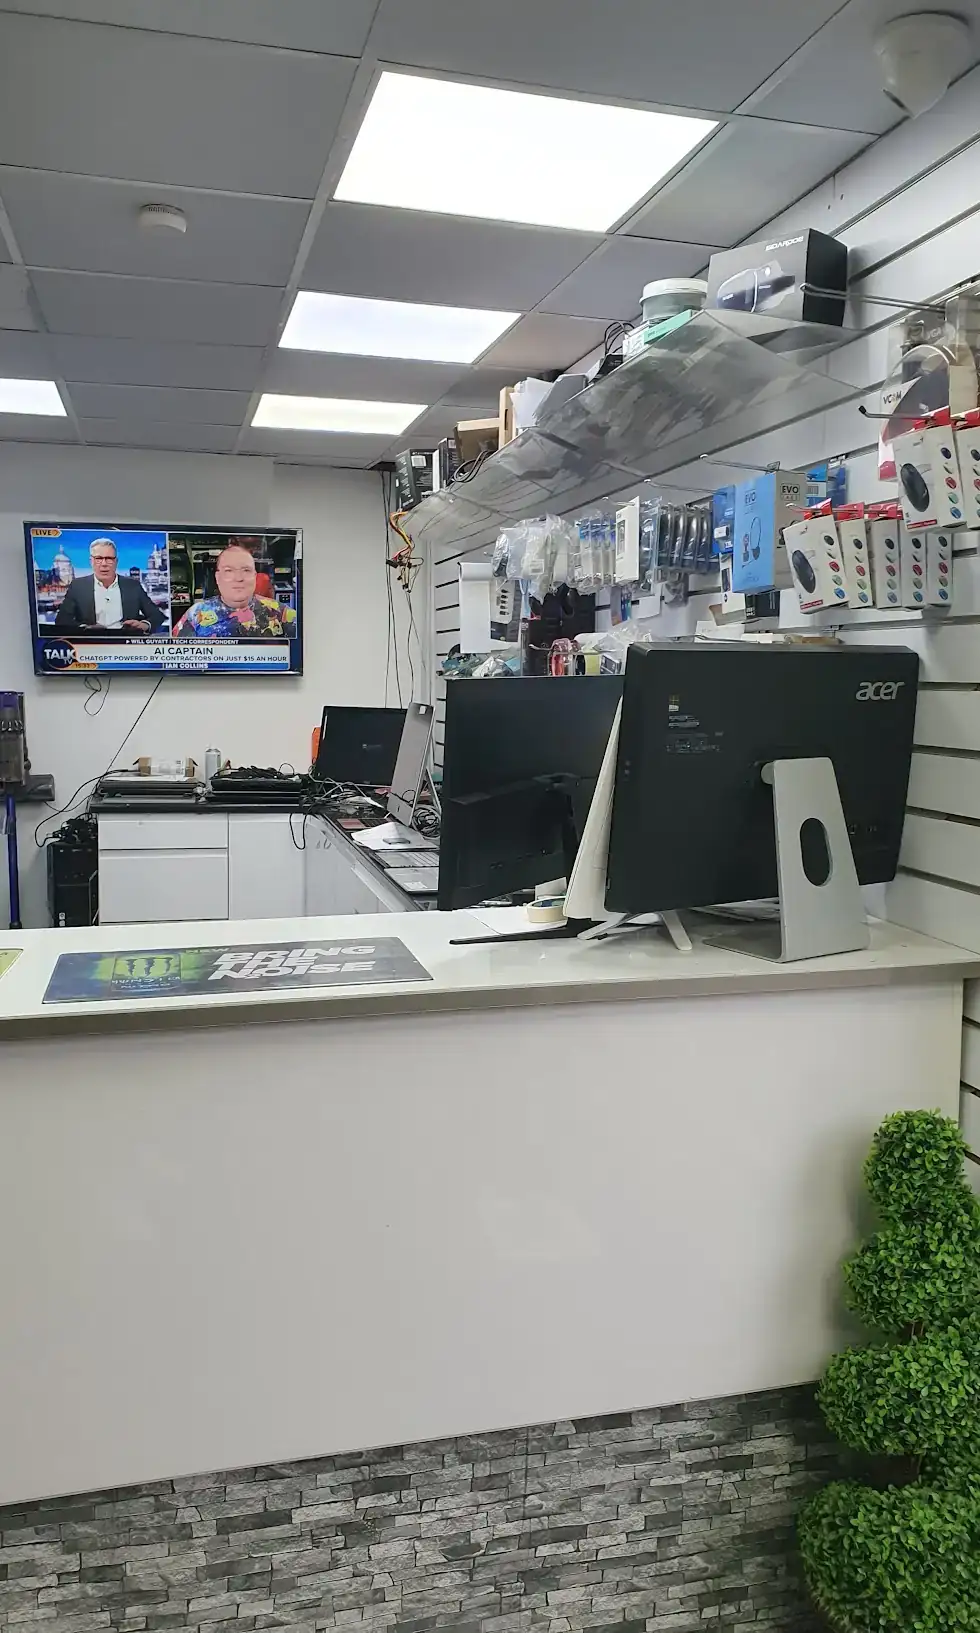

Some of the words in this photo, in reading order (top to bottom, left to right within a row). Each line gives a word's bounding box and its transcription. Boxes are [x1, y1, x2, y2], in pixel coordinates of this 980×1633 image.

[782, 485, 799, 494] EVO
[43, 649, 76, 660] TALK
[154, 647, 165, 655] AI
[167, 647, 213, 655] CAPTAIN
[856, 681, 905, 701] acer
[217, 945, 376, 962] BRING
[207, 960, 376, 980] NOISE
[213, 955, 320, 971] THE
